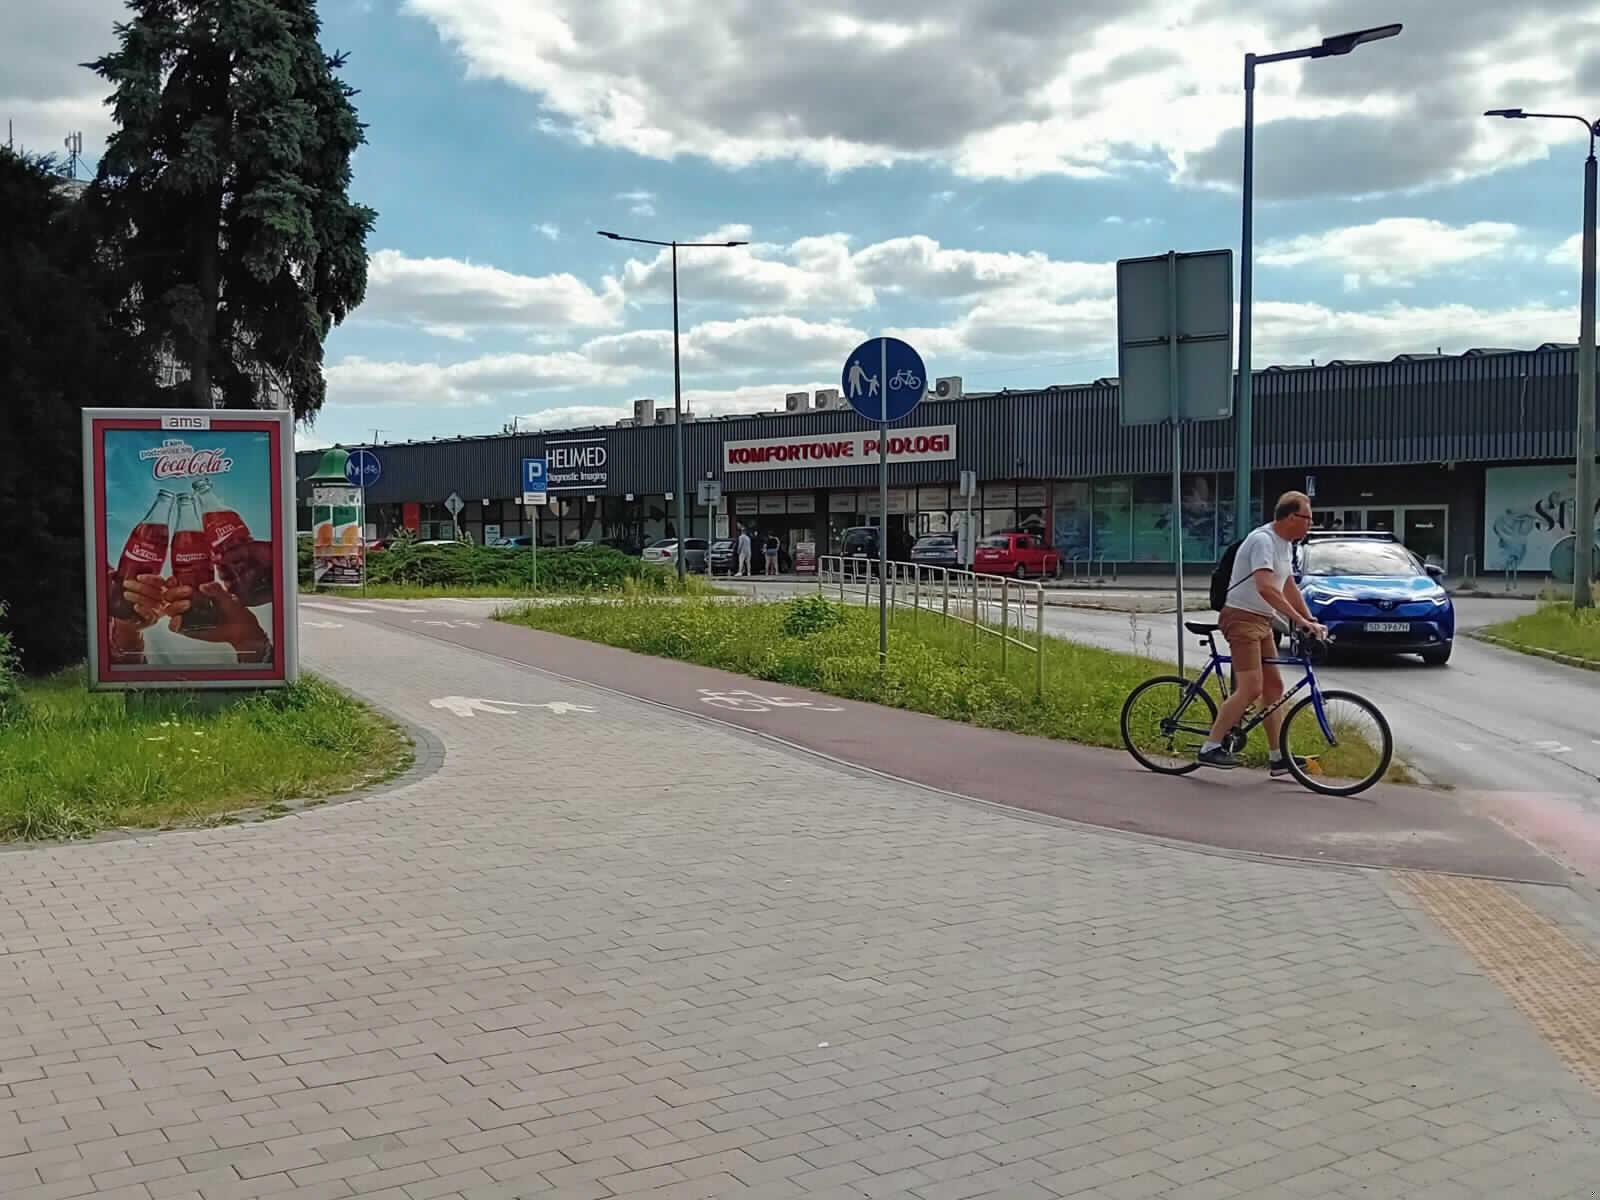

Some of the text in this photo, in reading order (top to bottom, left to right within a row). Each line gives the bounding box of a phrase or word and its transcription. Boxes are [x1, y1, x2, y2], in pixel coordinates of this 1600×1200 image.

[169, 416, 202, 428] ams
[545, 446, 607, 469] HELIMED
[728, 434, 950, 465] KOMFORTOWE PODŁOGI
[528, 462, 542, 483] P
[580, 471, 607, 482] Imaging
